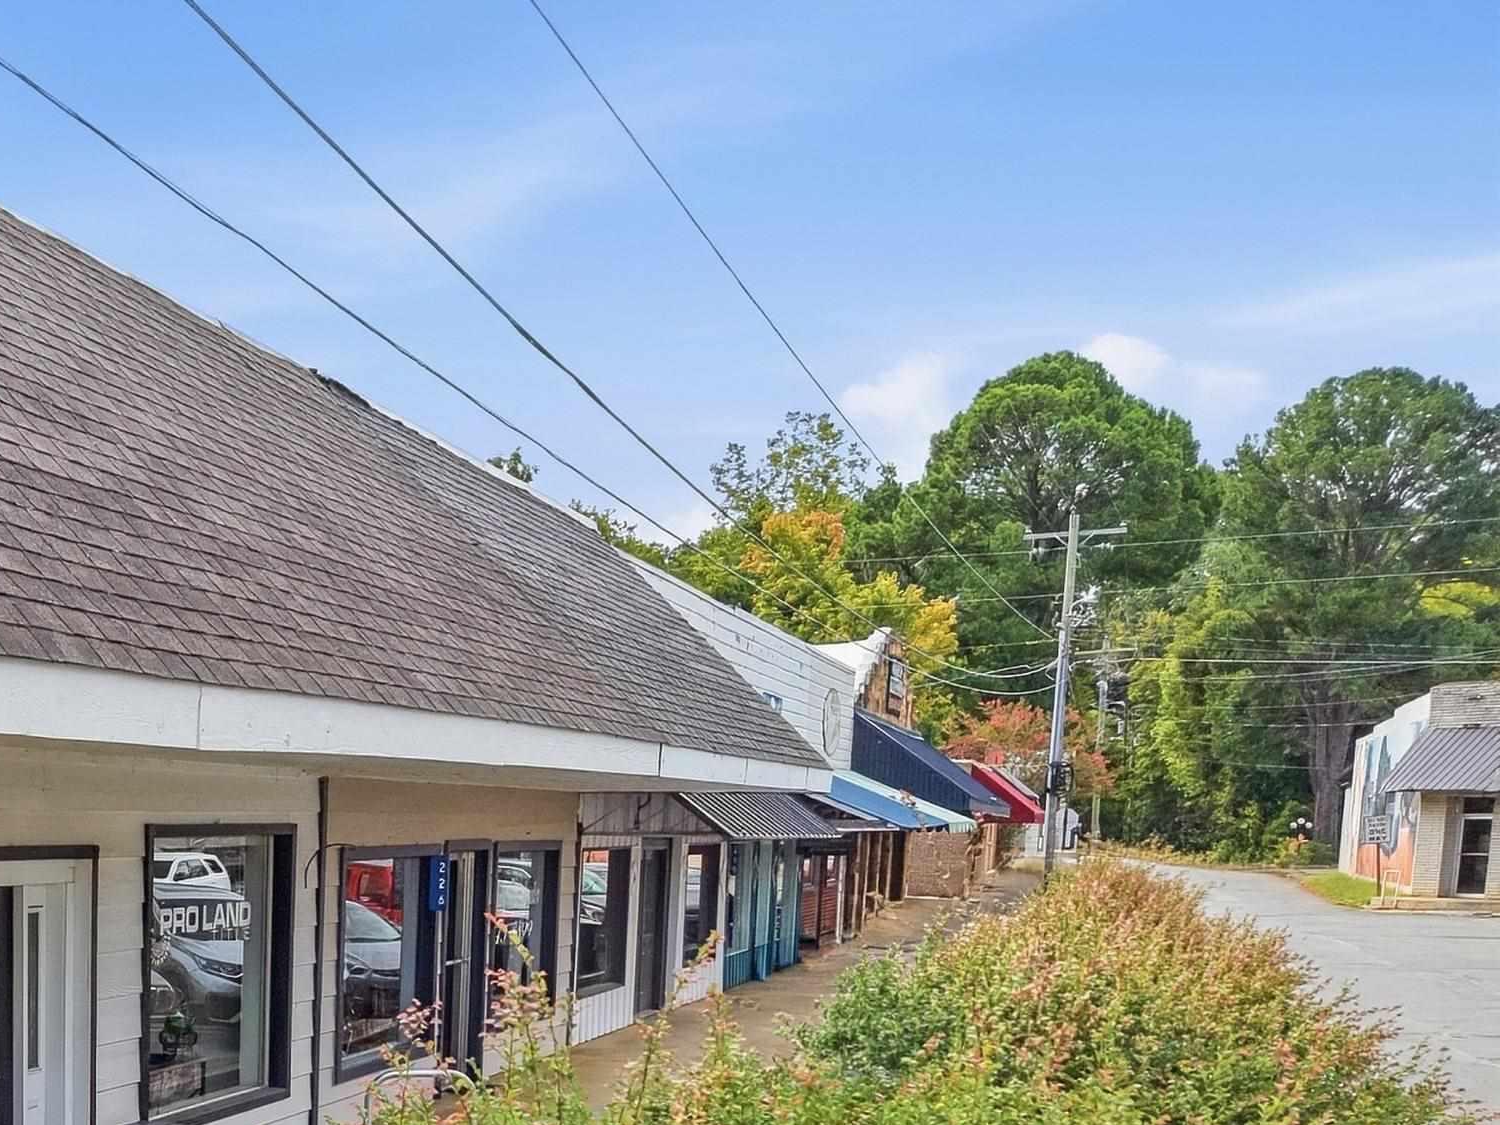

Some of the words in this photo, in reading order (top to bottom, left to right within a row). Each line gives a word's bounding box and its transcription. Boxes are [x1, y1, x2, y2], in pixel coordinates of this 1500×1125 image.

[437, 861, 446, 905] 226
[160, 906, 199, 936] PRO
[202, 901, 251, 931] LAND
